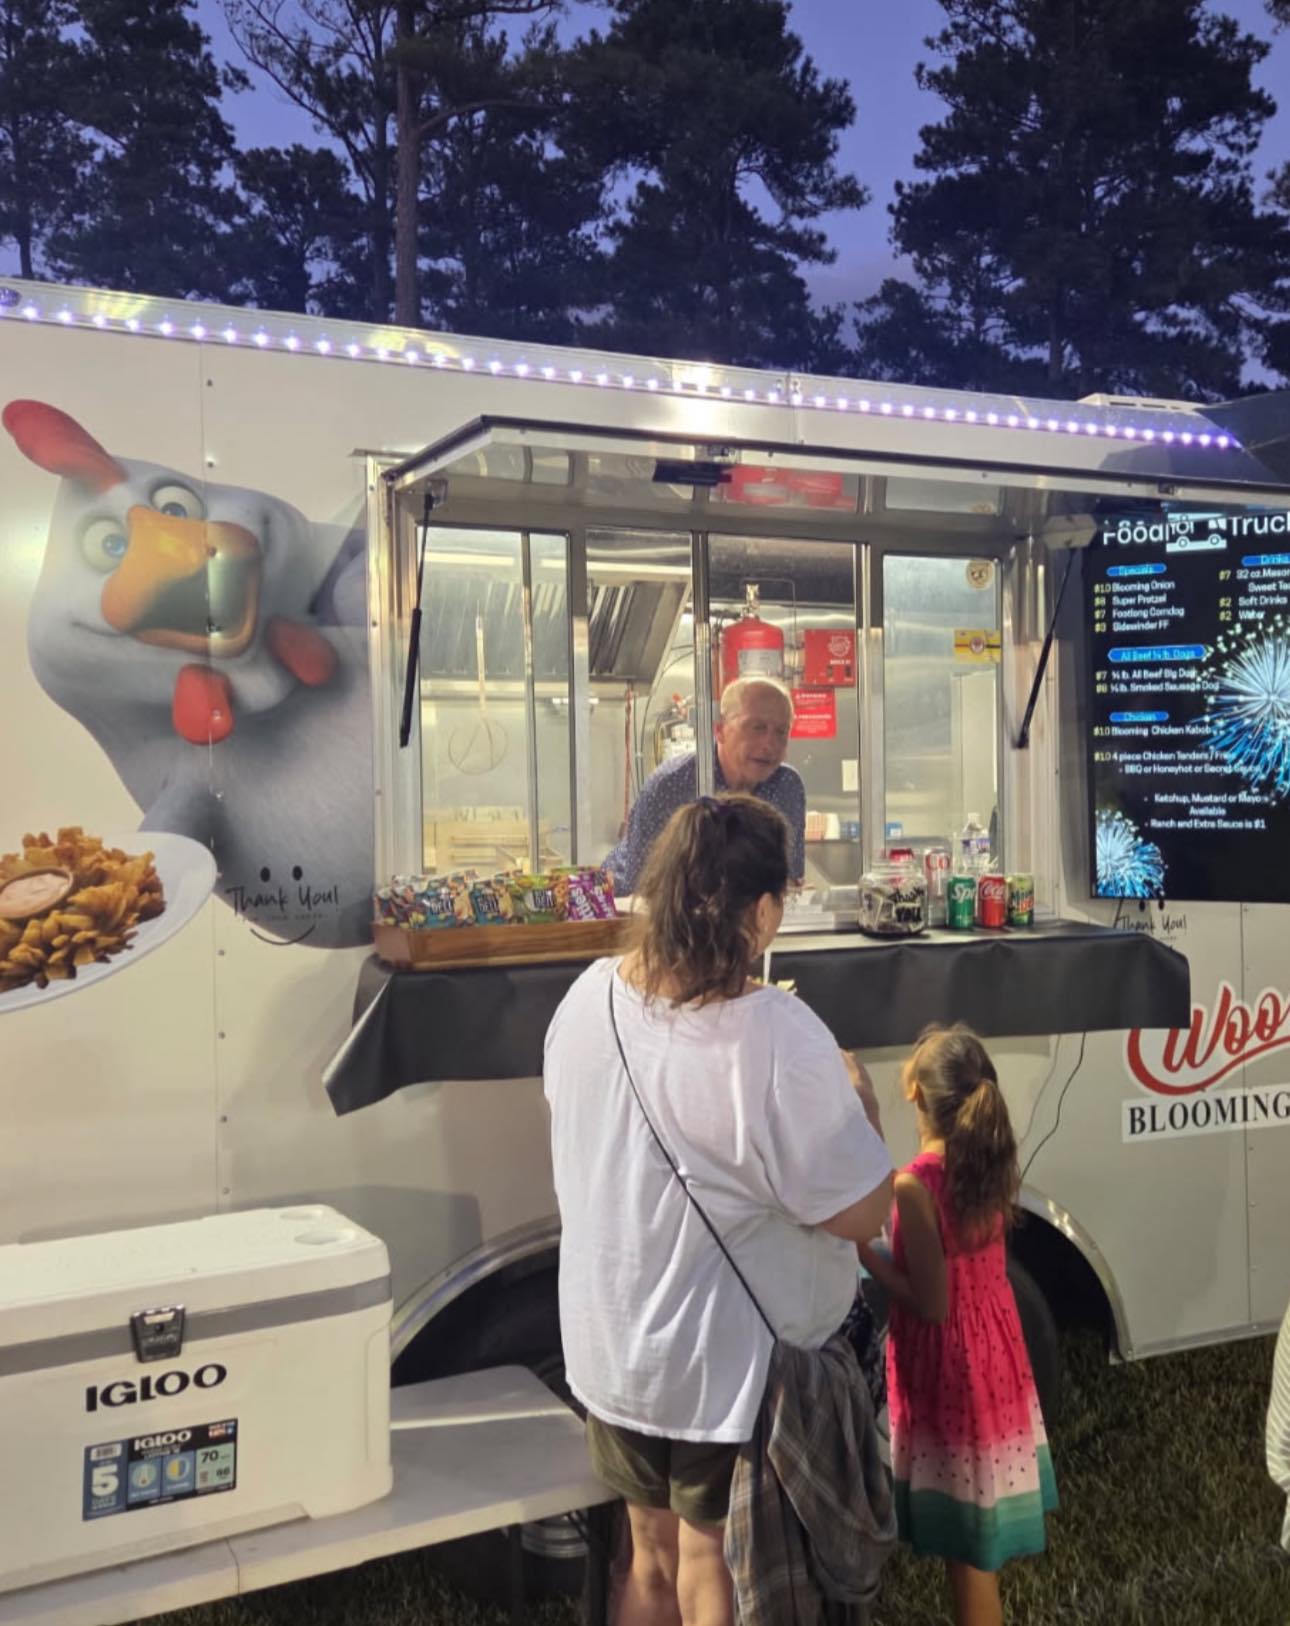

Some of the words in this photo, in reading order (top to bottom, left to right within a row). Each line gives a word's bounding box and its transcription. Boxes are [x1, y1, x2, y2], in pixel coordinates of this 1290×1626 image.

[1229, 512, 1290, 536] Truc
[1112, 581, 1150, 593] Blooming
[1150, 580, 1176, 591] Onion
[1248, 582, 1277, 593] Sweet
[1112, 595, 1136, 606] Super
[1137, 593, 1167, 605] Pretzel
[1238, 595, 1258, 606] Soft
[1259, 594, 1288, 606] Drinks
[1112, 608, 1149, 619] Footlong
[1149, 606, 1185, 618] Corndog
[1238, 609, 1266, 620] Water
[1131, 669, 1143, 679] All
[1143, 668, 1163, 679] Beef
[1163, 667, 1178, 680] Big
[1130, 681, 1164, 692] Smoked
[1164, 682, 1201, 693] Sausage
[1201, 680, 1220, 692] Dog
[1111, 725, 1149, 738] Blooming
[1151, 725, 1184, 735] Chicken
[1118, 751, 1141, 762] piece
[1142, 750, 1175, 761] Chicken
[1177, 749, 1209, 761] Tenders
[1143, 765, 1152, 773] or
[1152, 763, 1193, 775] Honeyhot
[1193, 765, 1203, 773] or
[1191, 792, 1228, 803] Mustard
[1228, 794, 1237, 803] or
[1189, 805, 1227, 816] Available
[1150, 818, 1176, 829] Ranch
[1177, 819, 1194, 829] and
[1194, 818, 1216, 829] Extra
[1217, 817, 1244, 829] Sauce
[1244, 818, 1253, 829] is
[225, 885, 288, 917] Thank
[1128, 1091, 1290, 1135] BLOOMING
[85, 1363, 228, 1413] IGLOO
[133, 1430, 192, 1451] IGLOO
[200, 1449, 219, 1464] 70
[91, 1464, 119, 1497] 5
